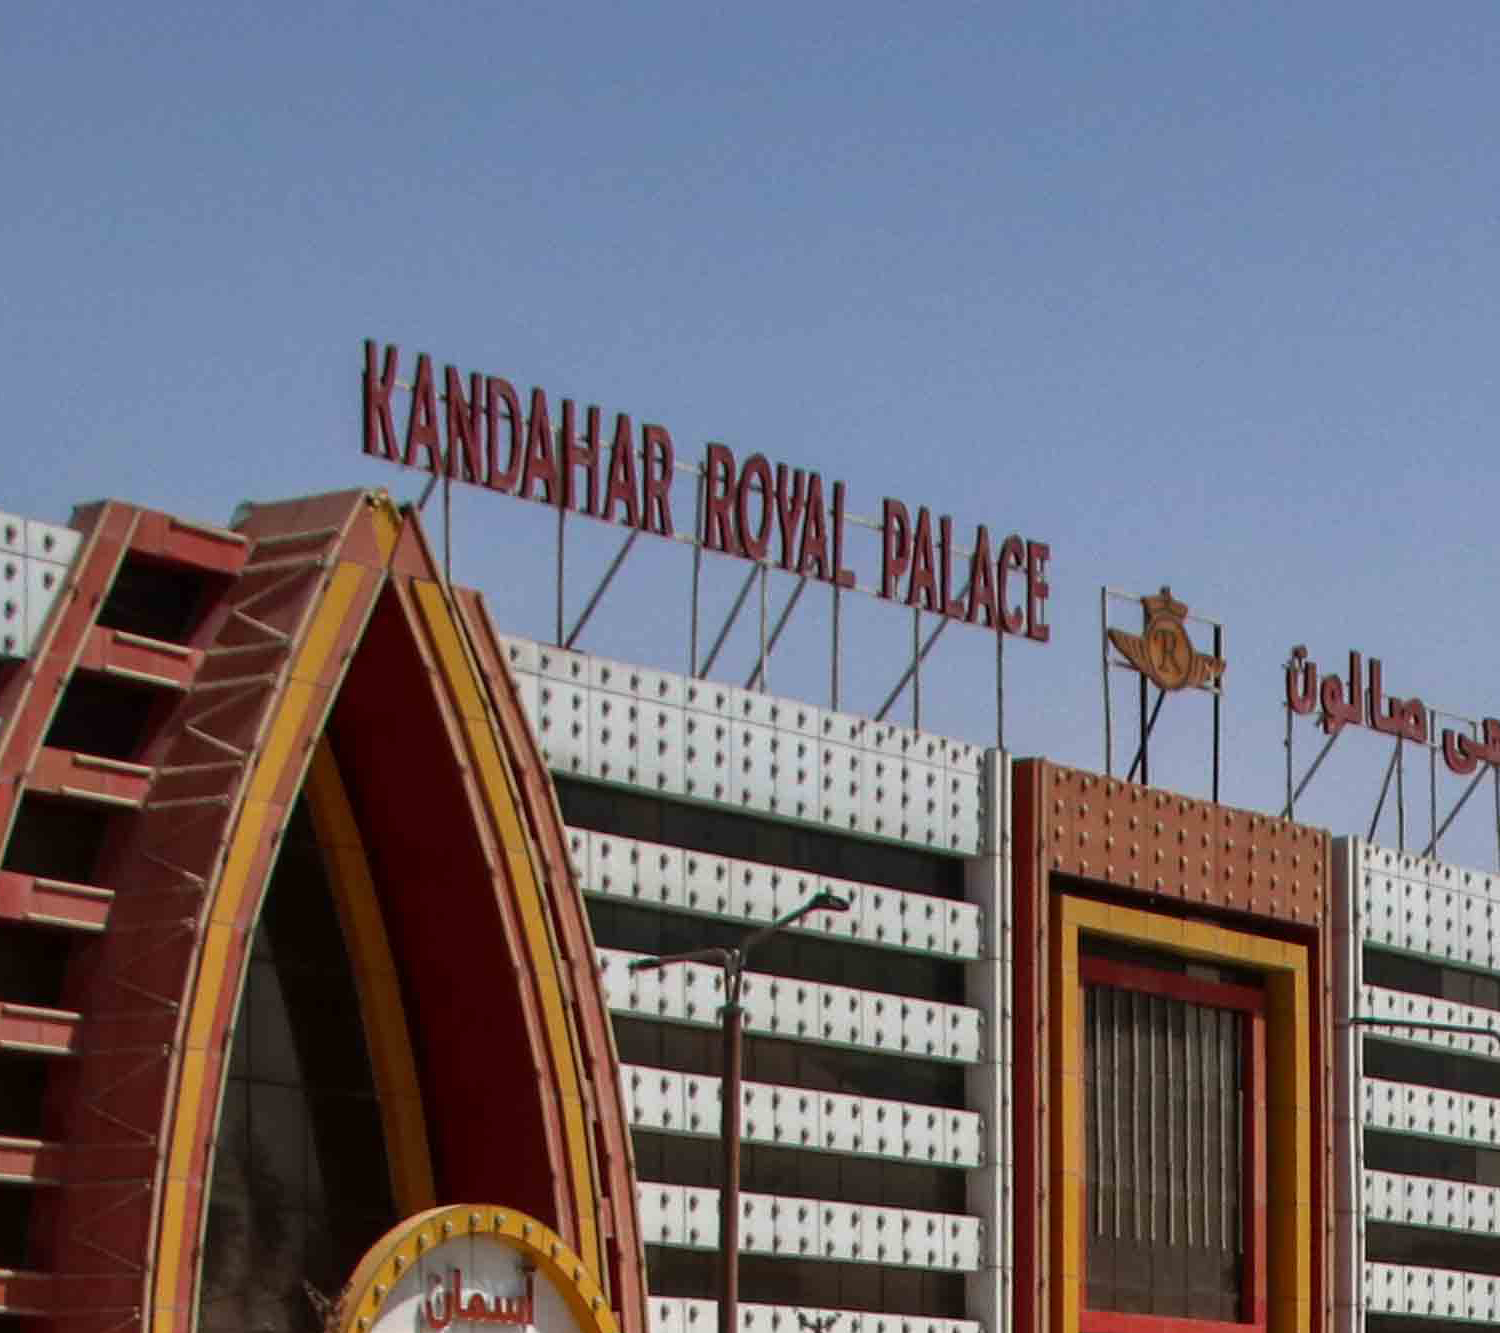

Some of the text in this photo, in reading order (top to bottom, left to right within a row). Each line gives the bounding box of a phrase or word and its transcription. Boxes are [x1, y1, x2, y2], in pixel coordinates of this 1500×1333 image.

[362, 338, 1050, 643] KANDAHAR ROYAL PALACE
